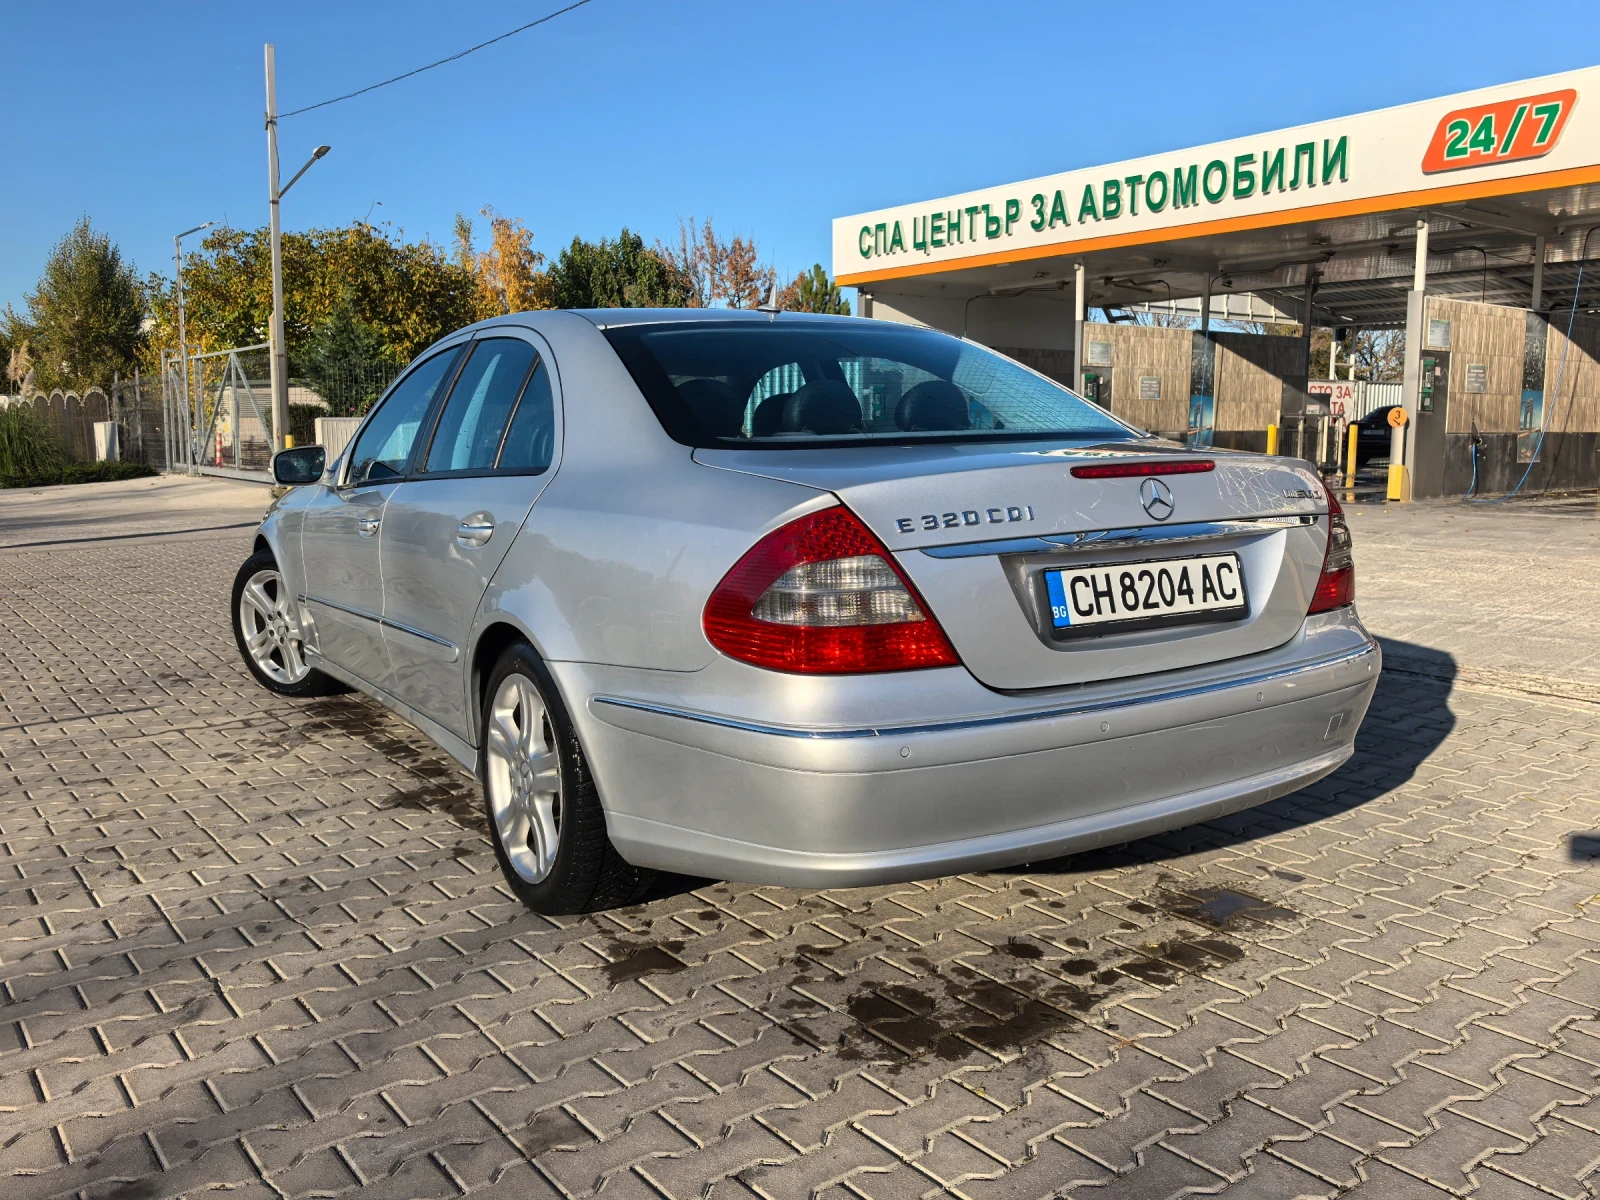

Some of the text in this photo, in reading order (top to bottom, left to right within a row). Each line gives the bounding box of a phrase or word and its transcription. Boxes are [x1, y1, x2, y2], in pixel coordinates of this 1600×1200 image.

[1444, 101, 1563, 160] 24/7
[858, 135, 1349, 258] СПА ЦЕНТЪР ЗА АВТОМОБИЛИ
[1395, 410, 1401, 420] 3
[895, 505, 1035, 533] E 320 CDI
[1118, 566, 1196, 612] 8204
[1202, 562, 1238, 603] AC
[1053, 605, 1068, 619] BG
